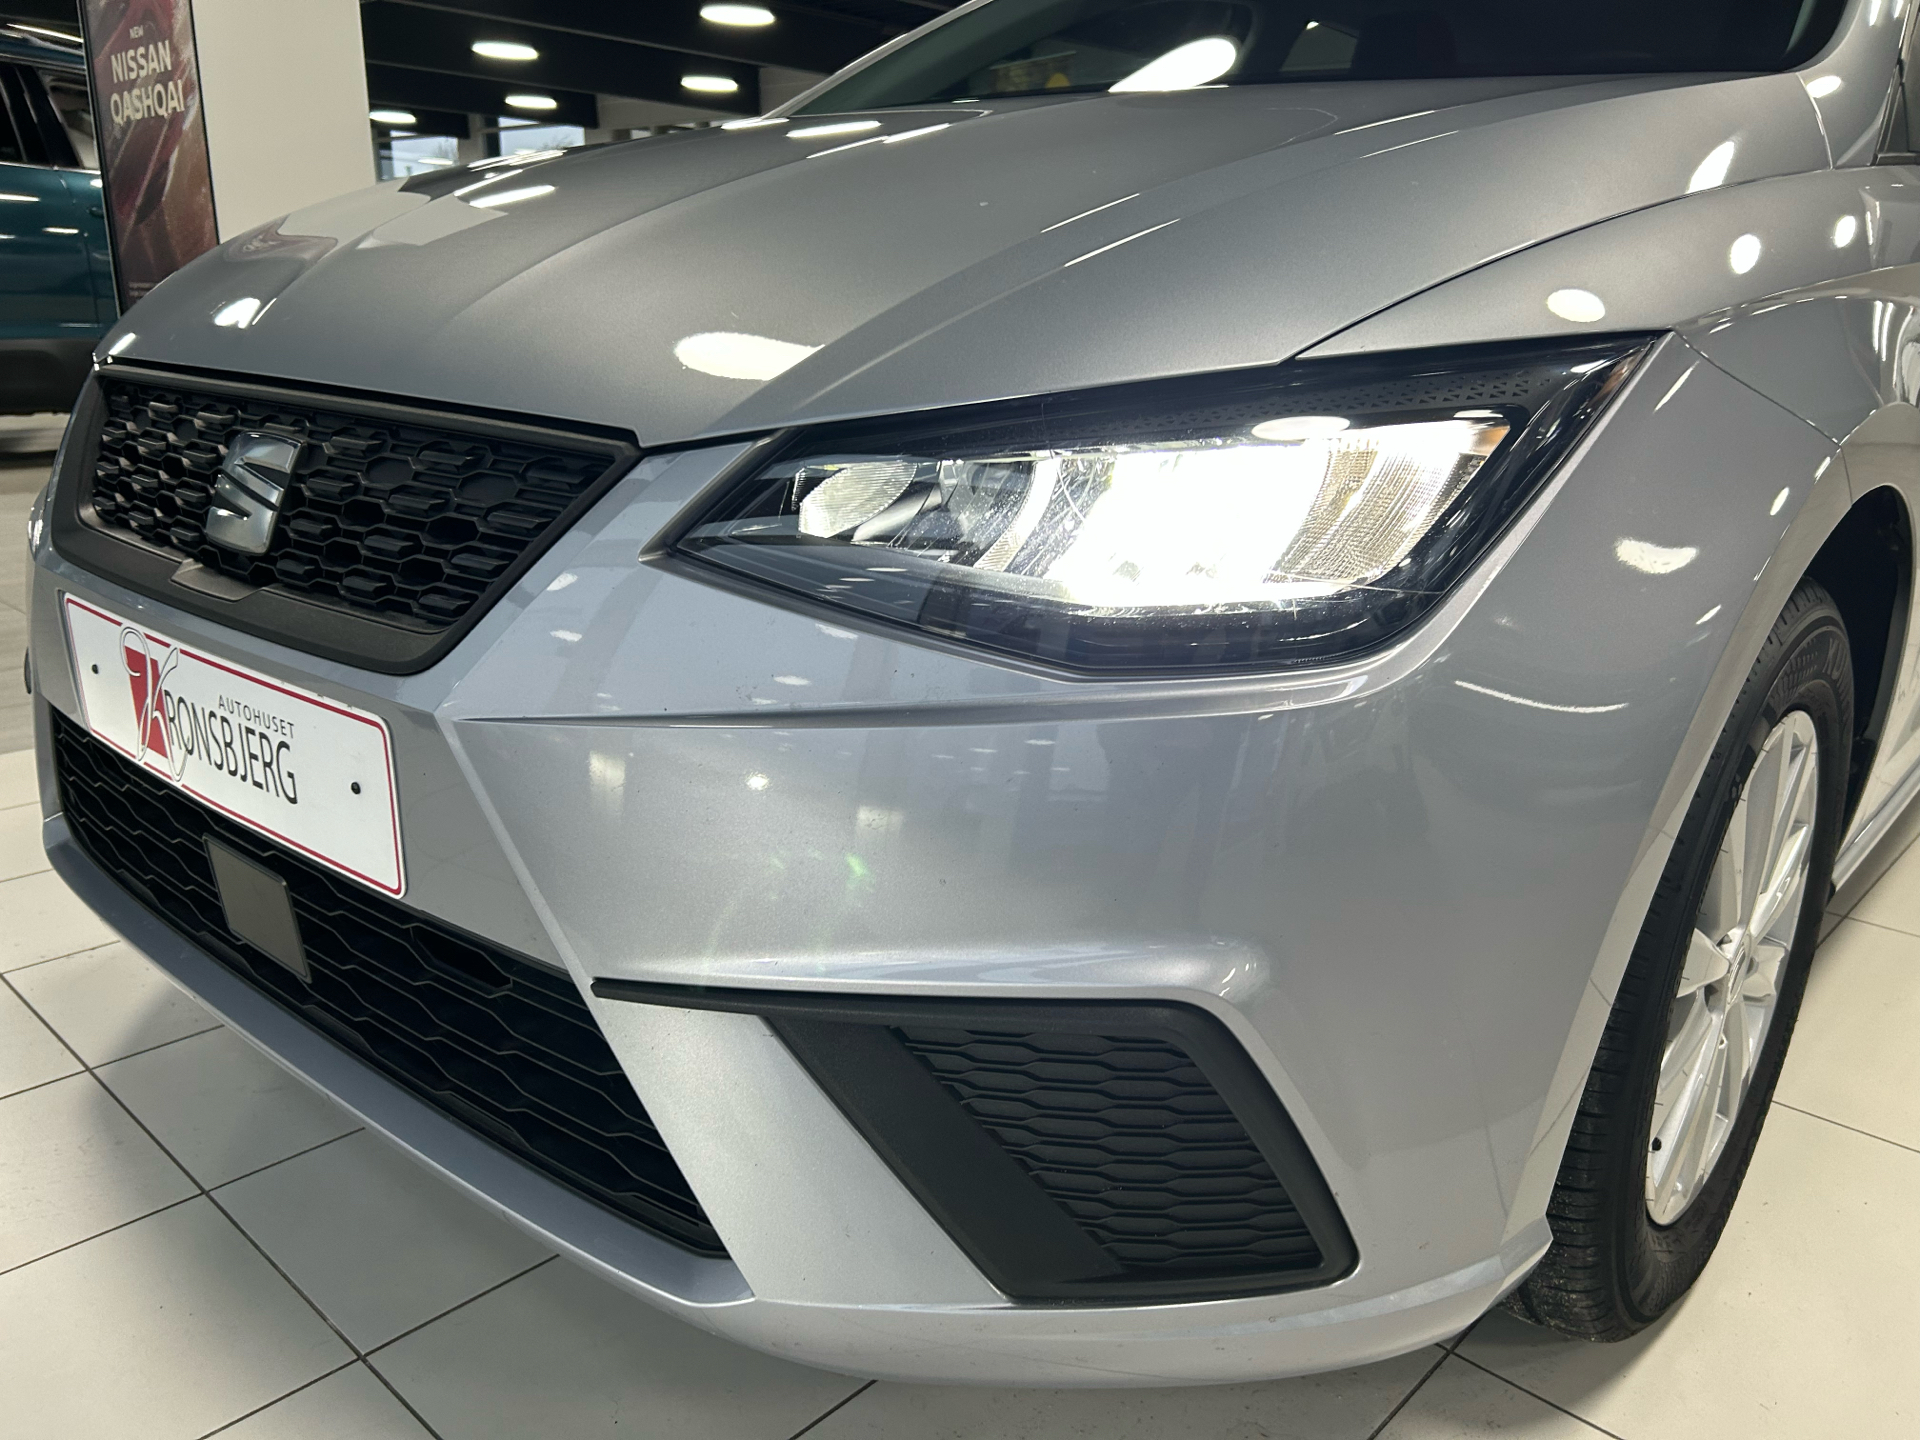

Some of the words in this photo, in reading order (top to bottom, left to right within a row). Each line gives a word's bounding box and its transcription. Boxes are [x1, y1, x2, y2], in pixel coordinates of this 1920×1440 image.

[129, 25, 144, 39] NEW
[110, 40, 172, 83] NISSAN
[110, 79, 185, 126] QASHQAI
[218, 694, 295, 739] AUTOHUSET
